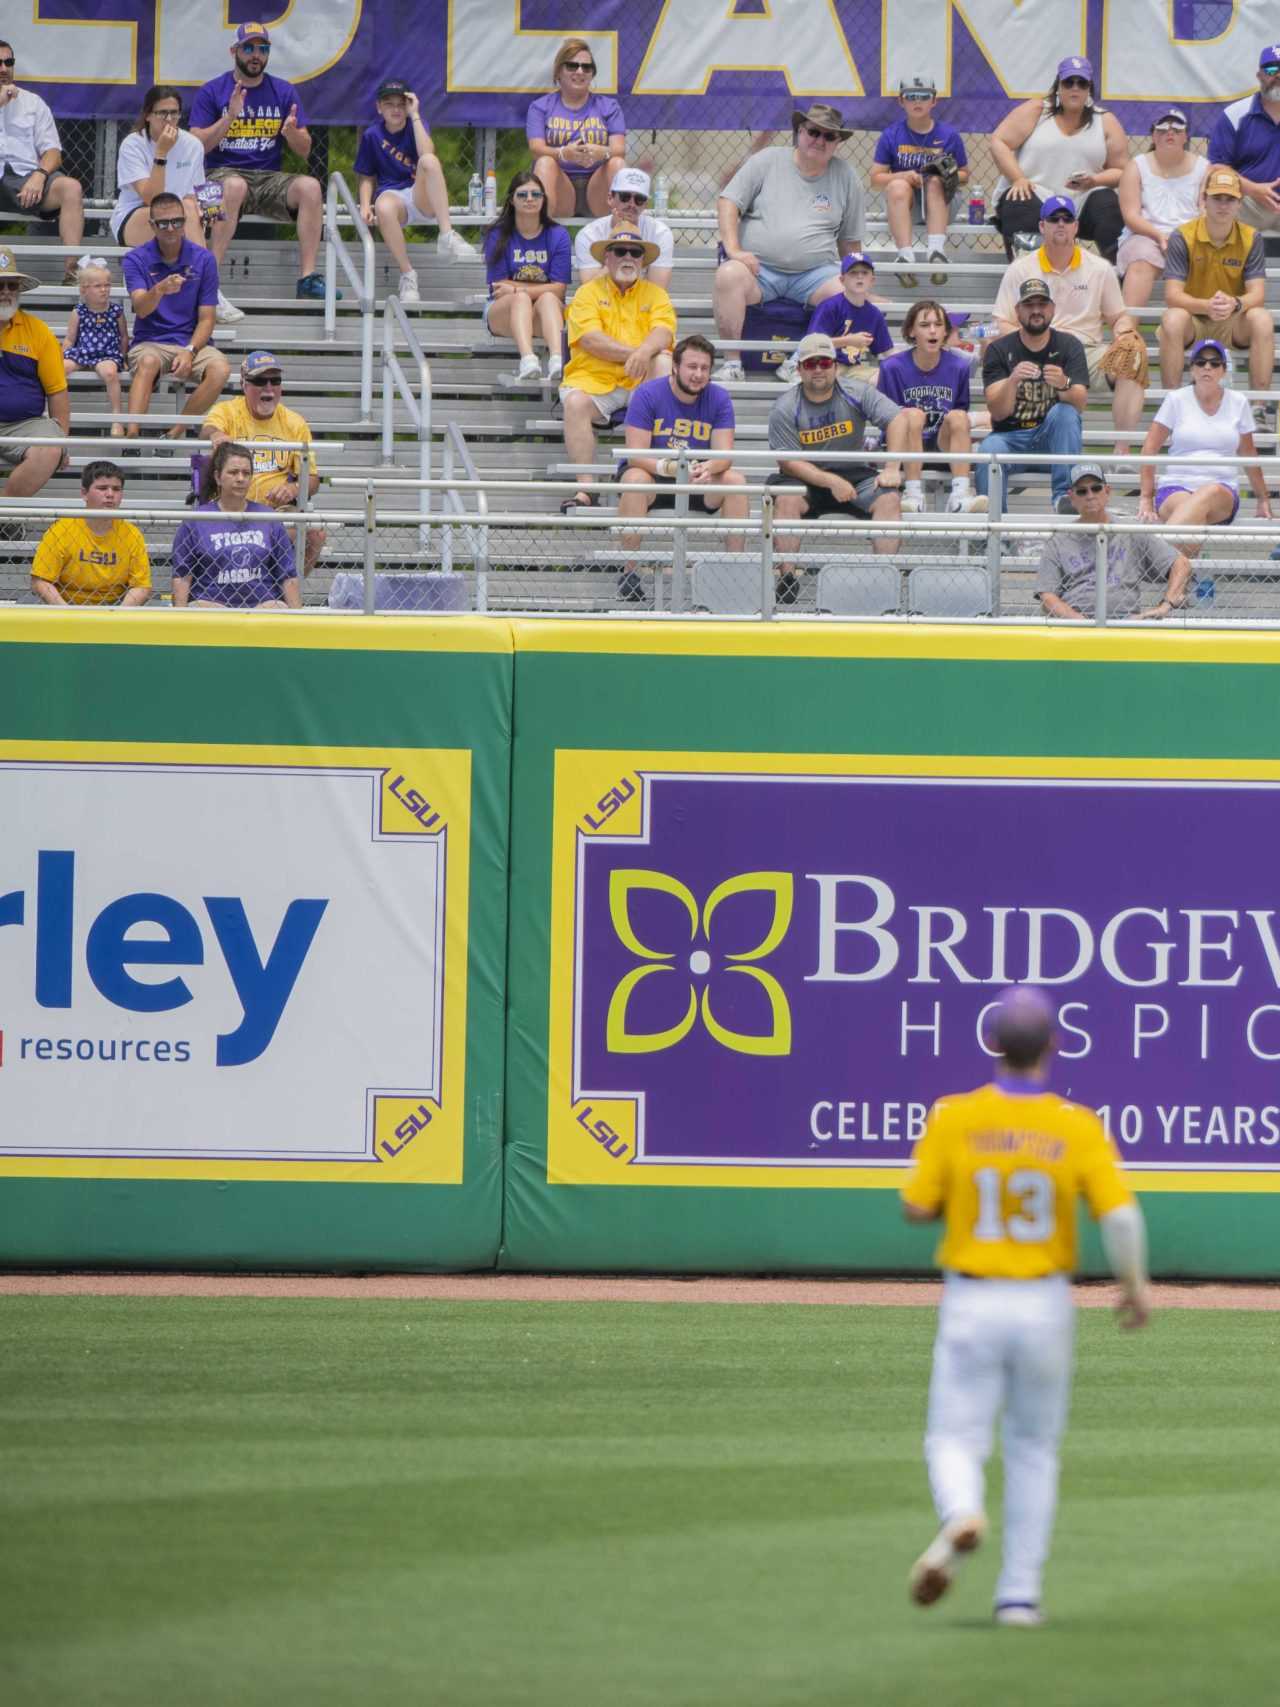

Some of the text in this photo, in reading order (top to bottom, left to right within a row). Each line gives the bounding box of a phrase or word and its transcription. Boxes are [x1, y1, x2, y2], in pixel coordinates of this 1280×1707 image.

[229, 118, 281, 129] OLLEGE
[513, 249, 548, 264] LSU
[652, 417, 713, 441] LSU
[800, 421, 851, 444] TIGERS
[79, 548, 117, 566] LSU
[388, 775, 441, 828] LSU
[583, 776, 636, 831] LSU
[20, 1036, 191, 1062] resources
[380, 1104, 433, 1158] LSU
[576, 1106, 631, 1159] LSU
[1096, 1105, 1143, 1144] 10
[973, 1166, 1057, 1243] 13
